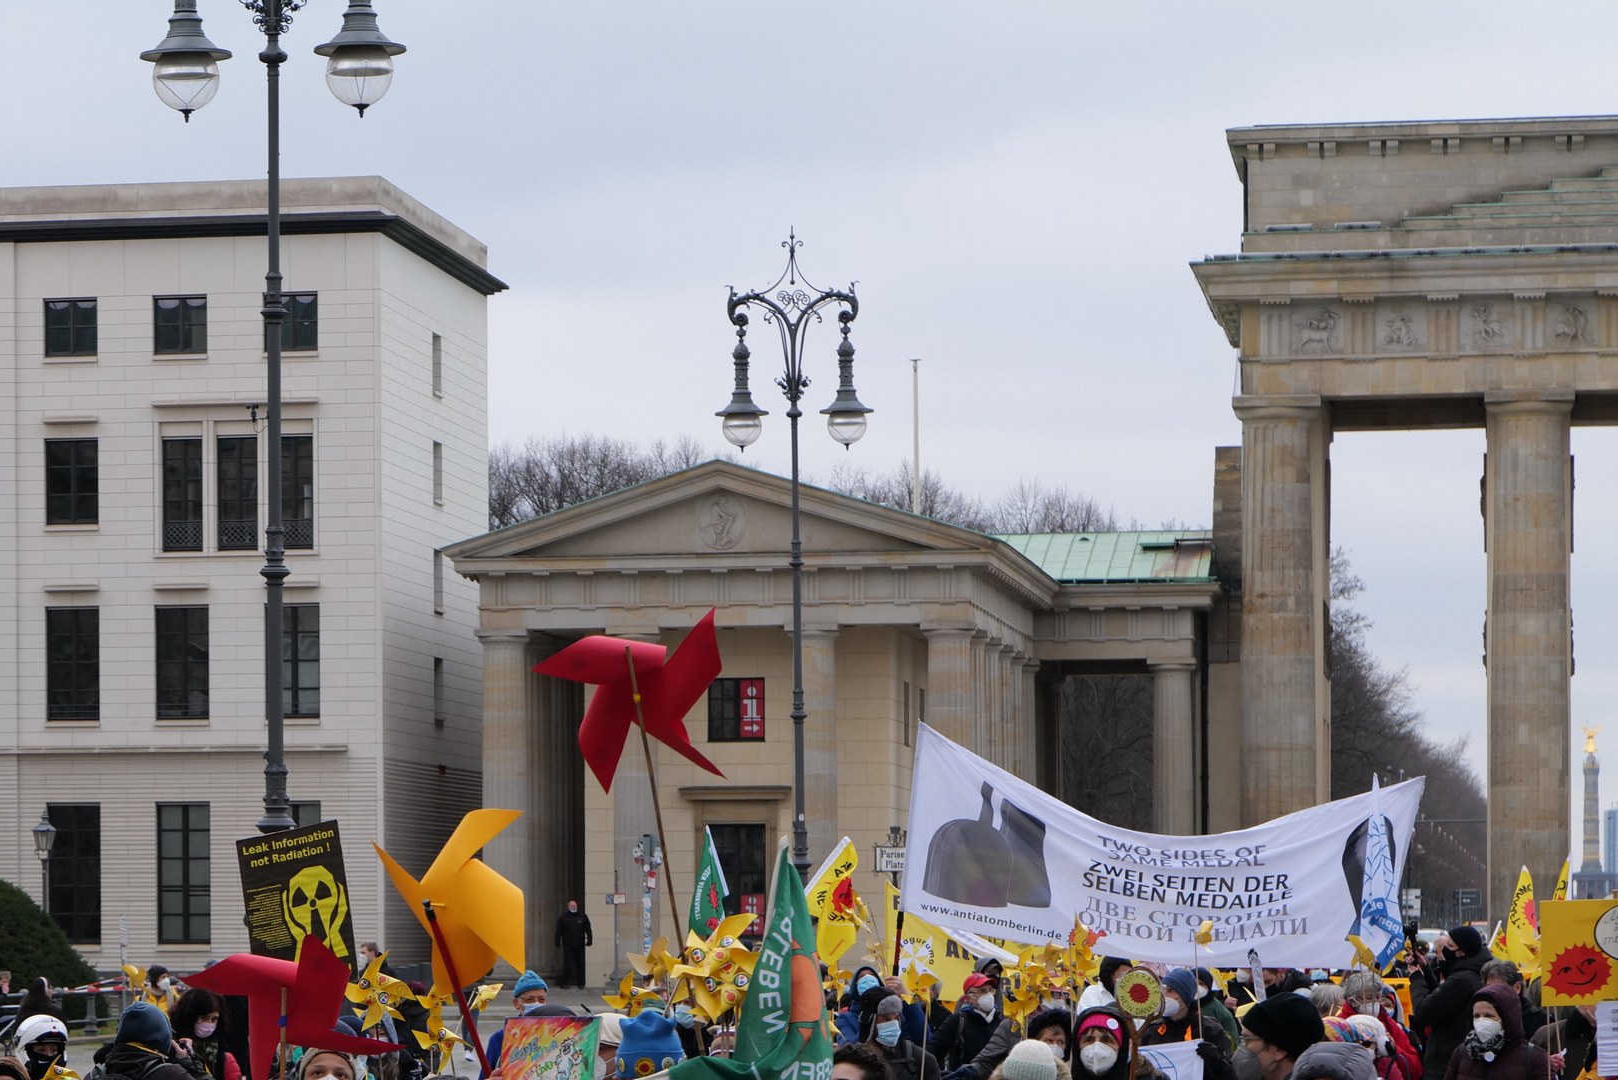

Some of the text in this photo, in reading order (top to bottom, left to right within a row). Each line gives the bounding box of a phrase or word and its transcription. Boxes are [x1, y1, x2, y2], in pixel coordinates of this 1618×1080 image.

[242, 829, 334, 856] Leak Information
[250, 842, 331, 868] not Radiation !
[881, 850, 905, 859] Parise
[1097, 835, 1266, 861] TWO SIDES OF
[1108, 850, 1266, 868] SAME MEDAL
[1089, 859, 1289, 893] ZWEI SEITEN DER
[1082, 872, 1294, 910] SELBEN MEDAILLE
[920, 903, 1062, 941] www.antiatomberlin.de
[1079, 910, 1174, 942] ОДНОЙ
[1086, 896, 1290, 928] ДВЕ СТОРОНЫ
